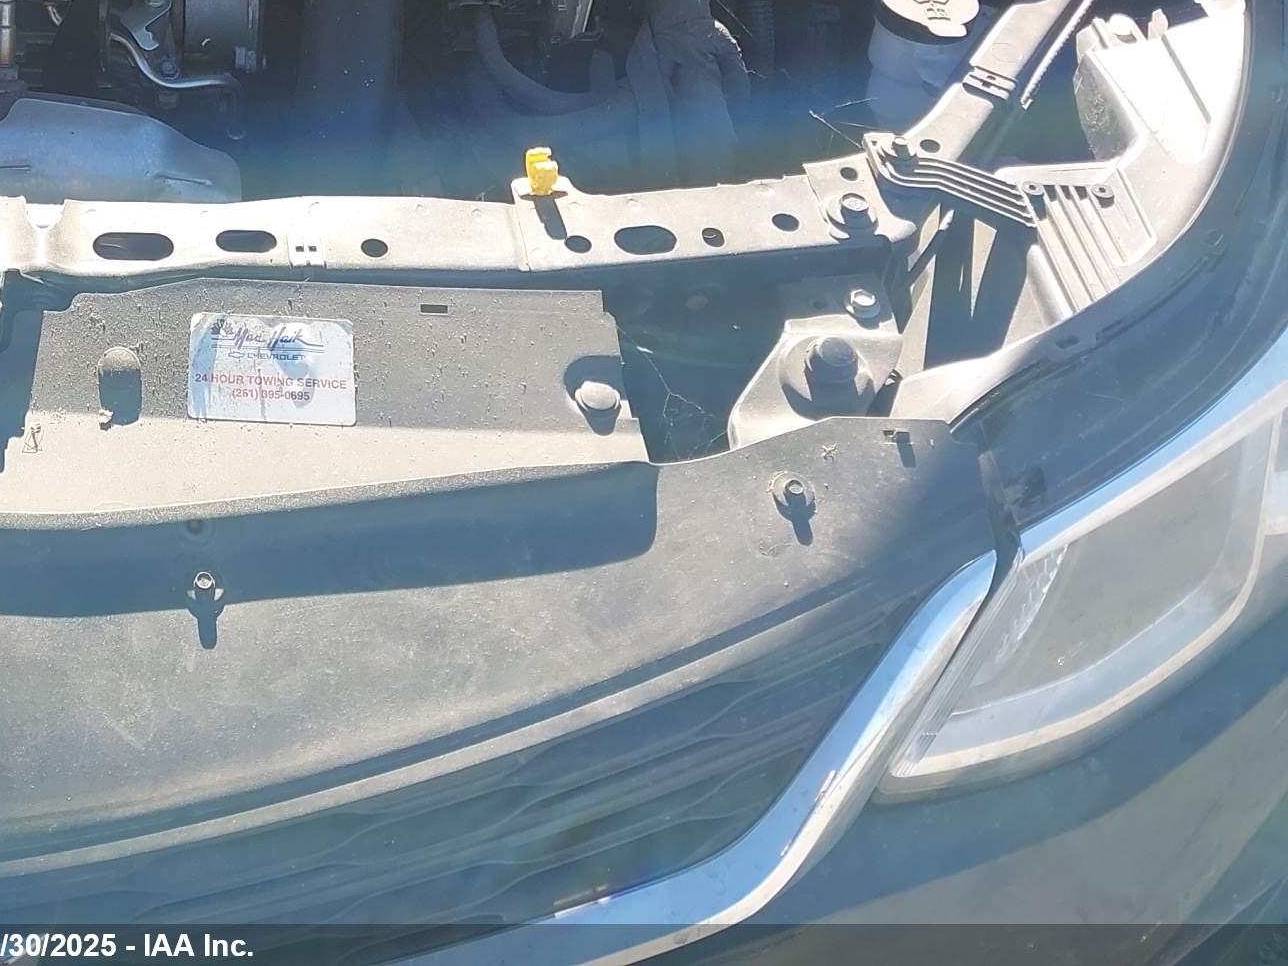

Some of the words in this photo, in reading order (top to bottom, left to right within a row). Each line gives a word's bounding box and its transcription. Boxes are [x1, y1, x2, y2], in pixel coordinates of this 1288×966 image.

[247, 352, 306, 361] CHEVROLET
[194, 373, 209, 383] 24
[210, 374, 244, 386] HOUR
[248, 376, 294, 388] TOWING
[297, 378, 347, 390] SERVICE
